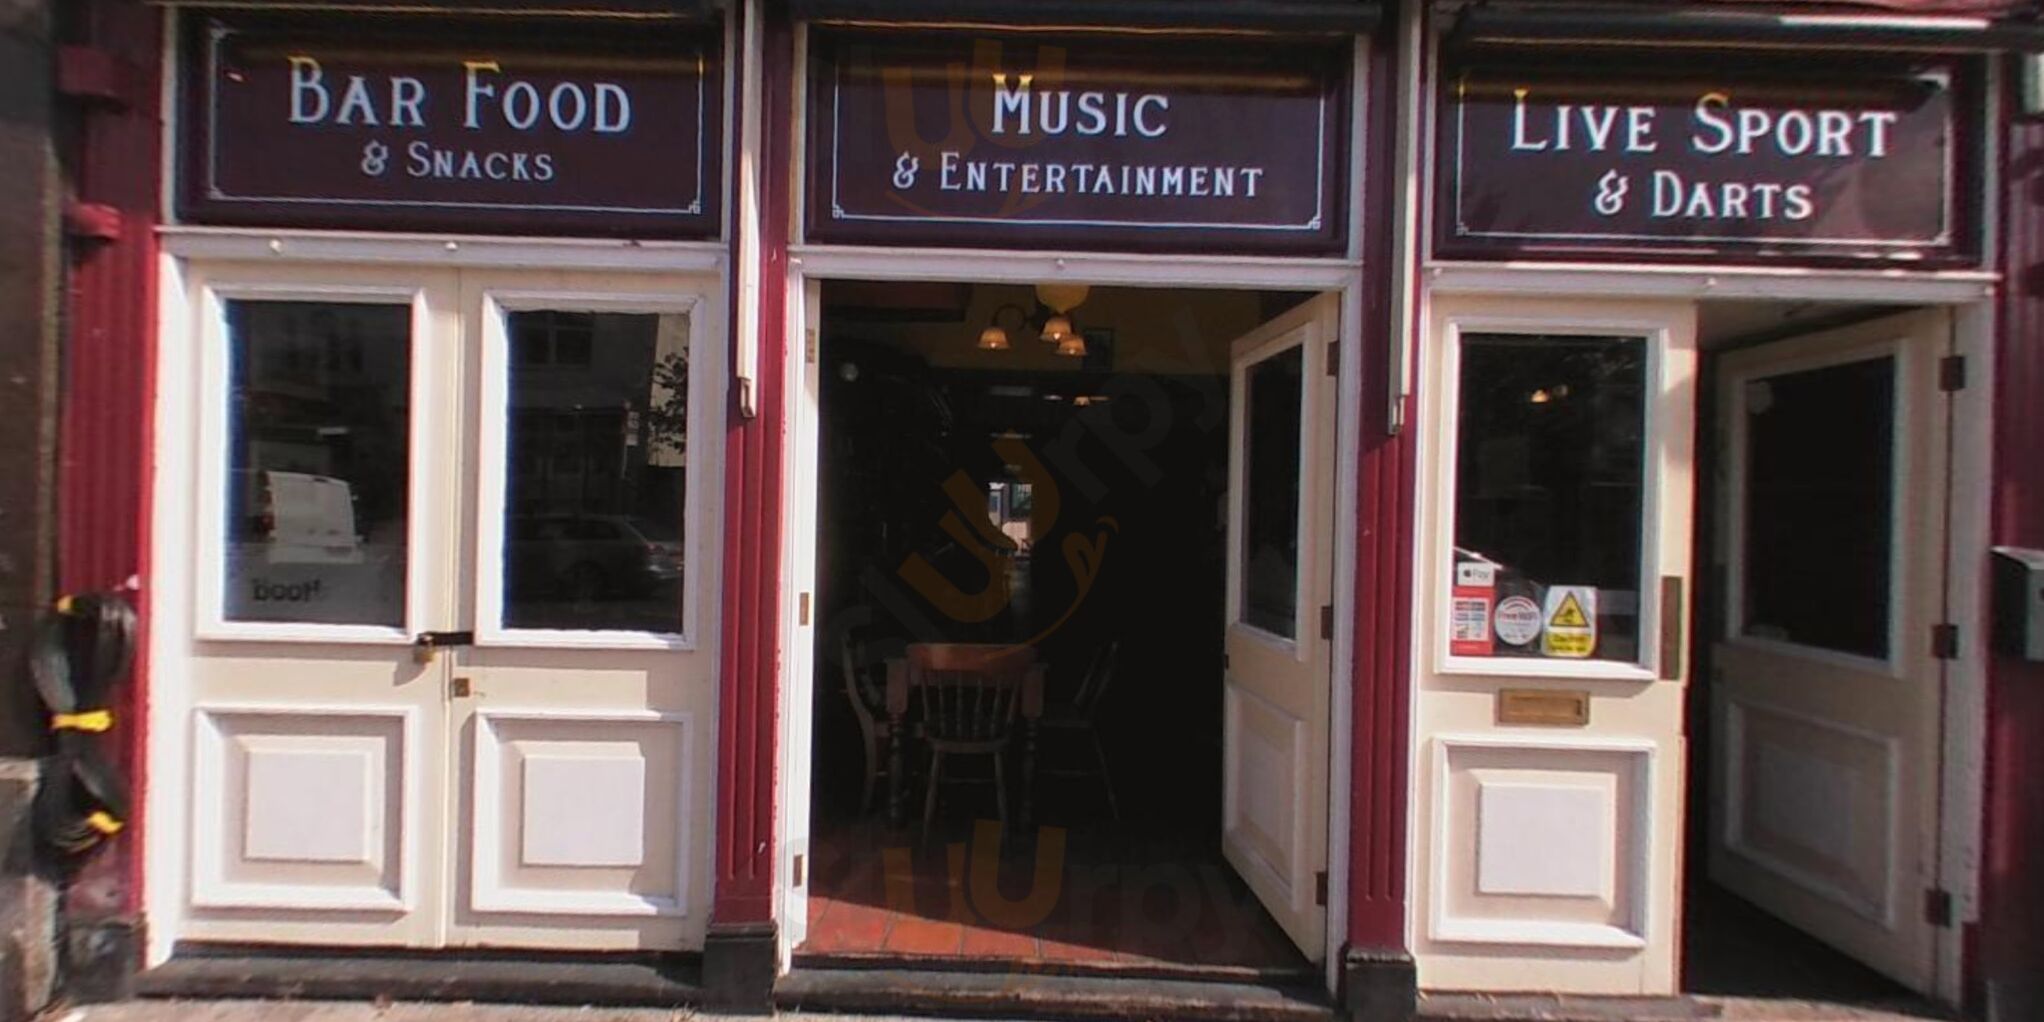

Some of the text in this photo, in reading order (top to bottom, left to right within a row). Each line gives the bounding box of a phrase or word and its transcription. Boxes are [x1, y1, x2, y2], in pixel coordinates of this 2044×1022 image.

[287, 55, 632, 132] BAR FOOD
[991, 72, 1169, 137] MUSIC
[1510, 88, 1898, 158] LIVE SPORT
[361, 140, 554, 181] & SNACKS
[893, 150, 1263, 198] & ENTERTAINMENT
[1594, 169, 1815, 220] & DARTS
